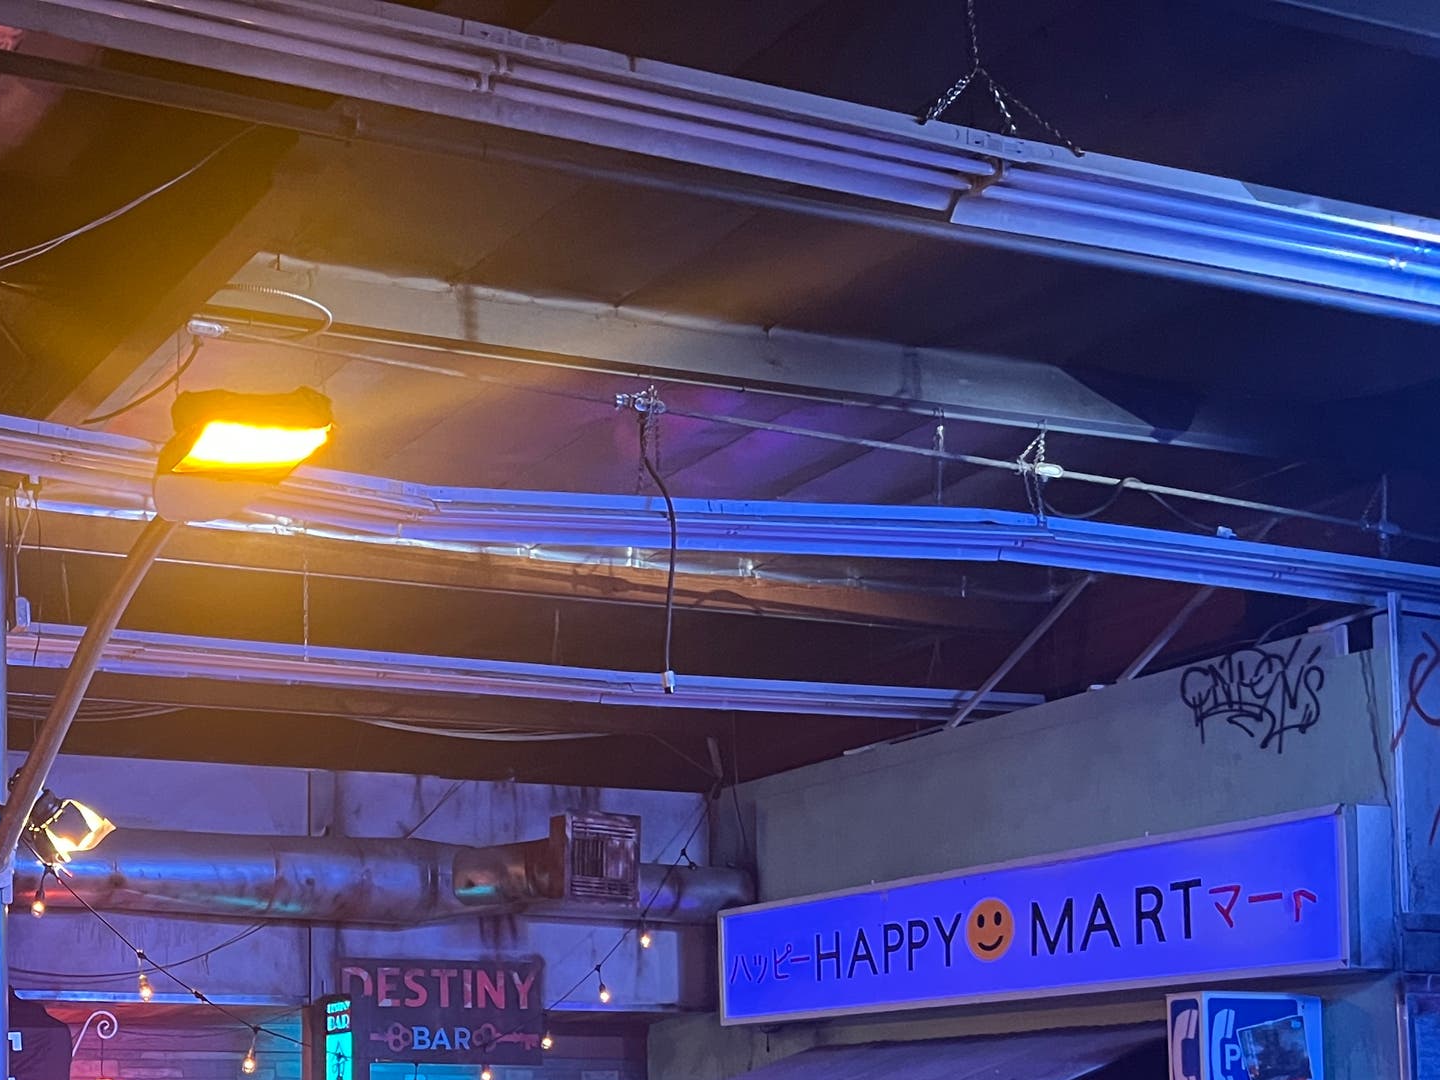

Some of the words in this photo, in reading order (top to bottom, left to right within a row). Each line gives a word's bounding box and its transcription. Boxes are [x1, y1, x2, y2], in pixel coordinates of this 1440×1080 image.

[729, 943, 811, 984] ハッピー
[813, 912, 962, 980] HAPPY
[1029, 878, 1202, 957] MART
[340, 966, 536, 1010] DESTINY
[411, 1026, 472, 1051] BAR
